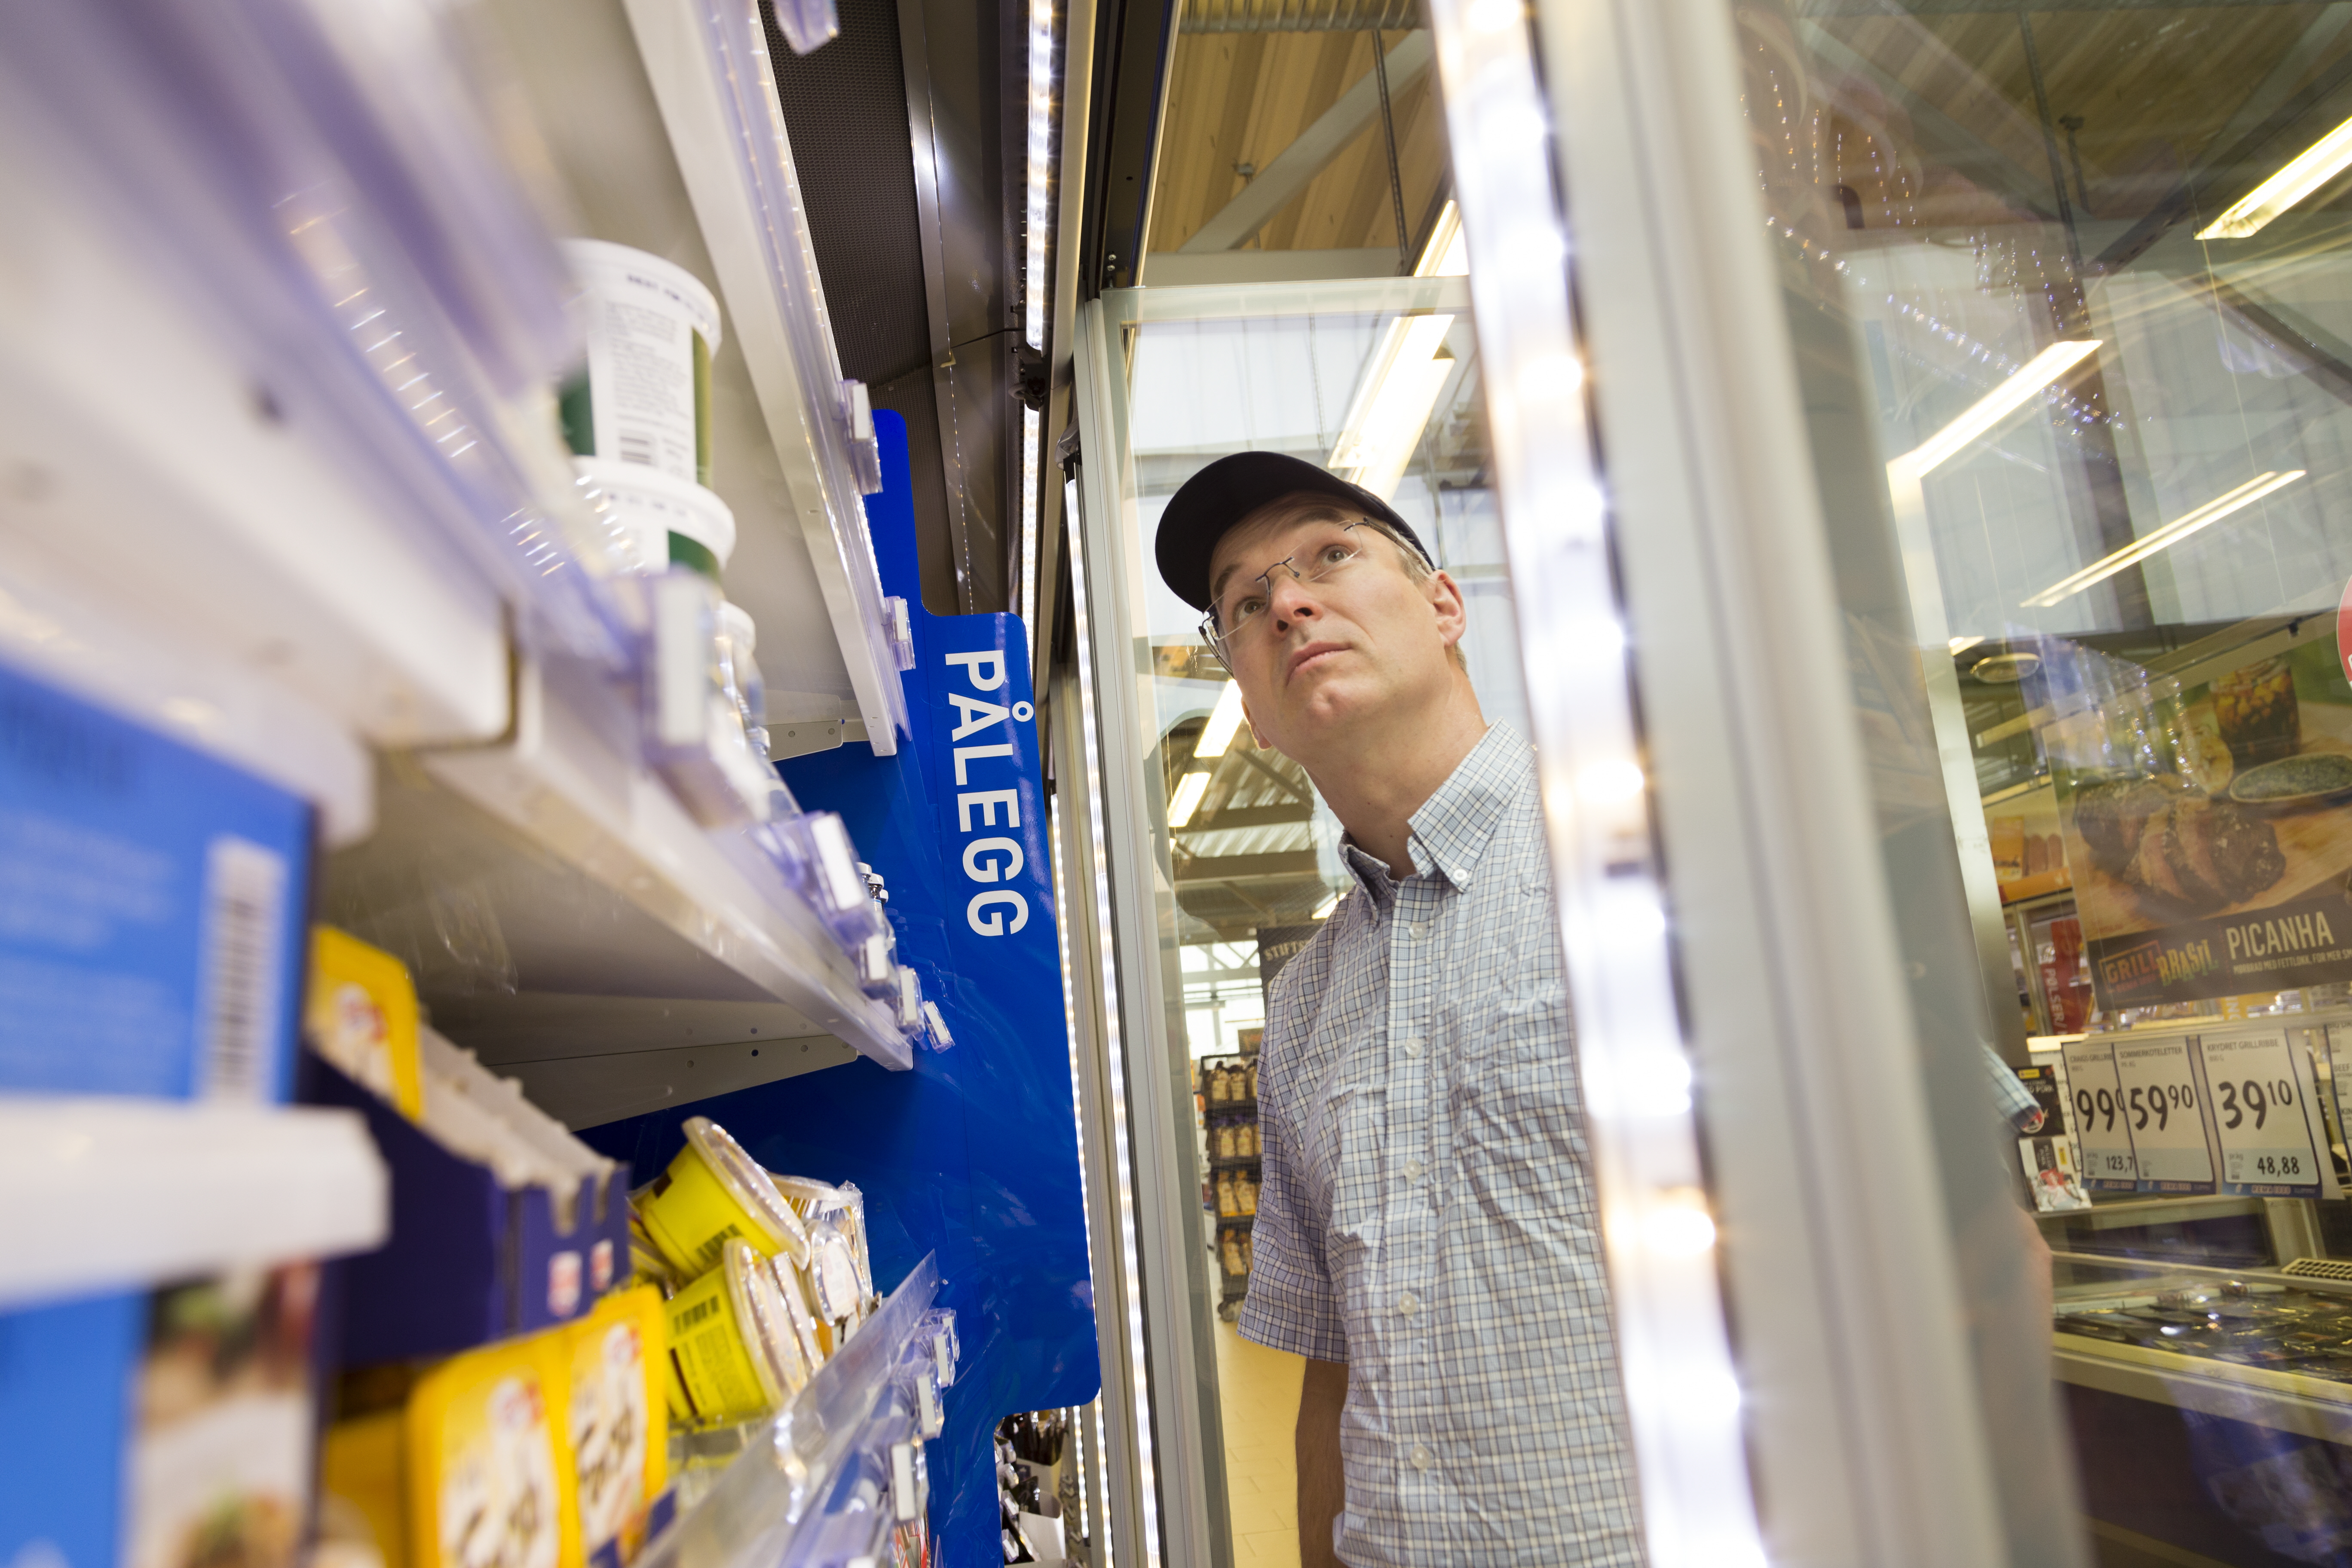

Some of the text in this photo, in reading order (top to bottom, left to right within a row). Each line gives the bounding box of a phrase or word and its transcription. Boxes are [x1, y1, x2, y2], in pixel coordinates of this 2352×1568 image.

[945, 650, 1034, 937] PÅLEGG
[2226, 911, 2335, 960] PICANHA
[1263, 939, 1311, 962] STIFTS
[2327, 949, 2341, 961] MER
[2106, 949, 2158, 984] GRILL
[2156, 939, 2219, 987] BRASIL
[2119, 1046, 2182, 1059] SOMMERKOTELETTER
[2207, 1038, 2279, 1051] KRYDRET GRILLRIBBE
[2089, 1053, 2113, 1062] GRILLRIB
[2106, 1155, 2133, 1173] 123,7
[2257, 1156, 2300, 1177] 48,88
